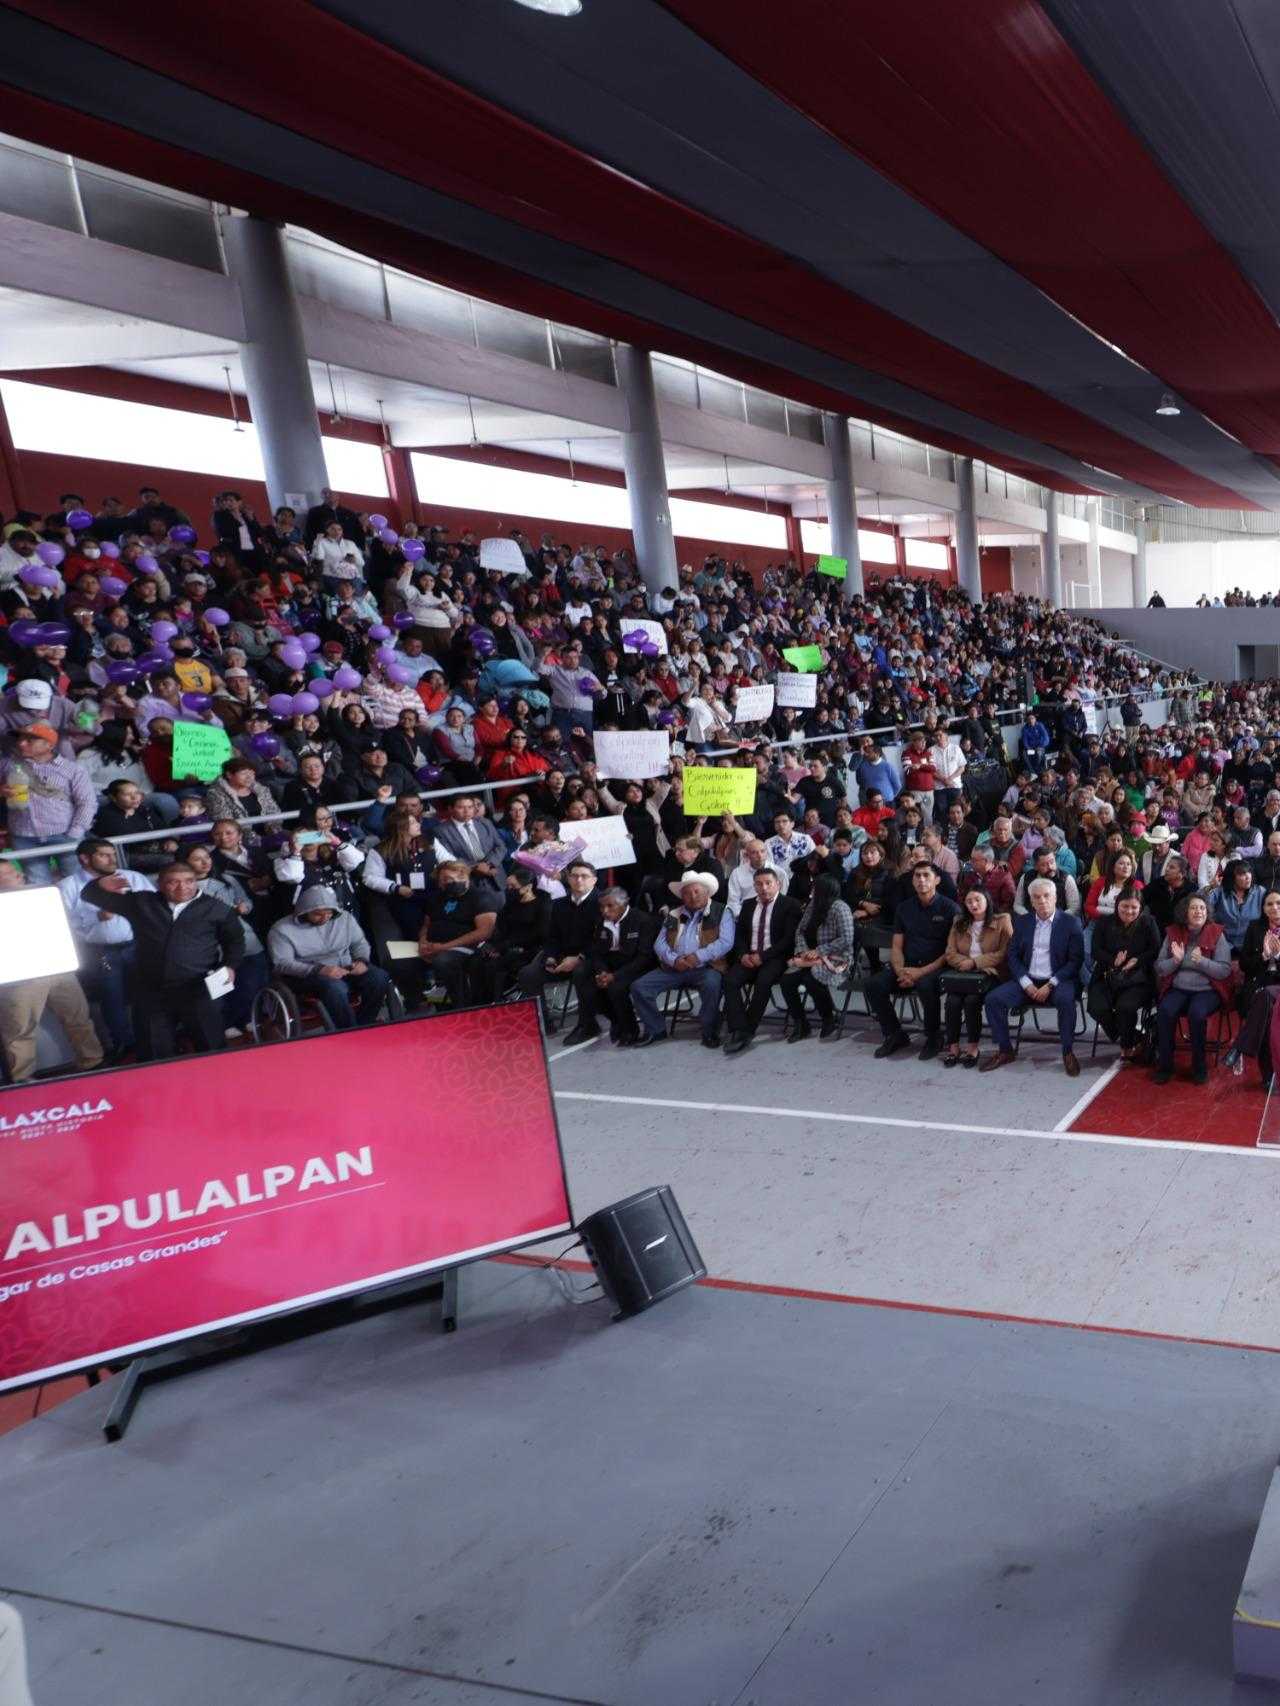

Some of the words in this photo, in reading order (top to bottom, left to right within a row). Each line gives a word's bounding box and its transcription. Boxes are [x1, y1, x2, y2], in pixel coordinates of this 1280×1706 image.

[4, 1146, 374, 1261] ALPULALPAN
[37, 1271, 66, 1288] de
[69, 1253, 136, 1280] Casas
